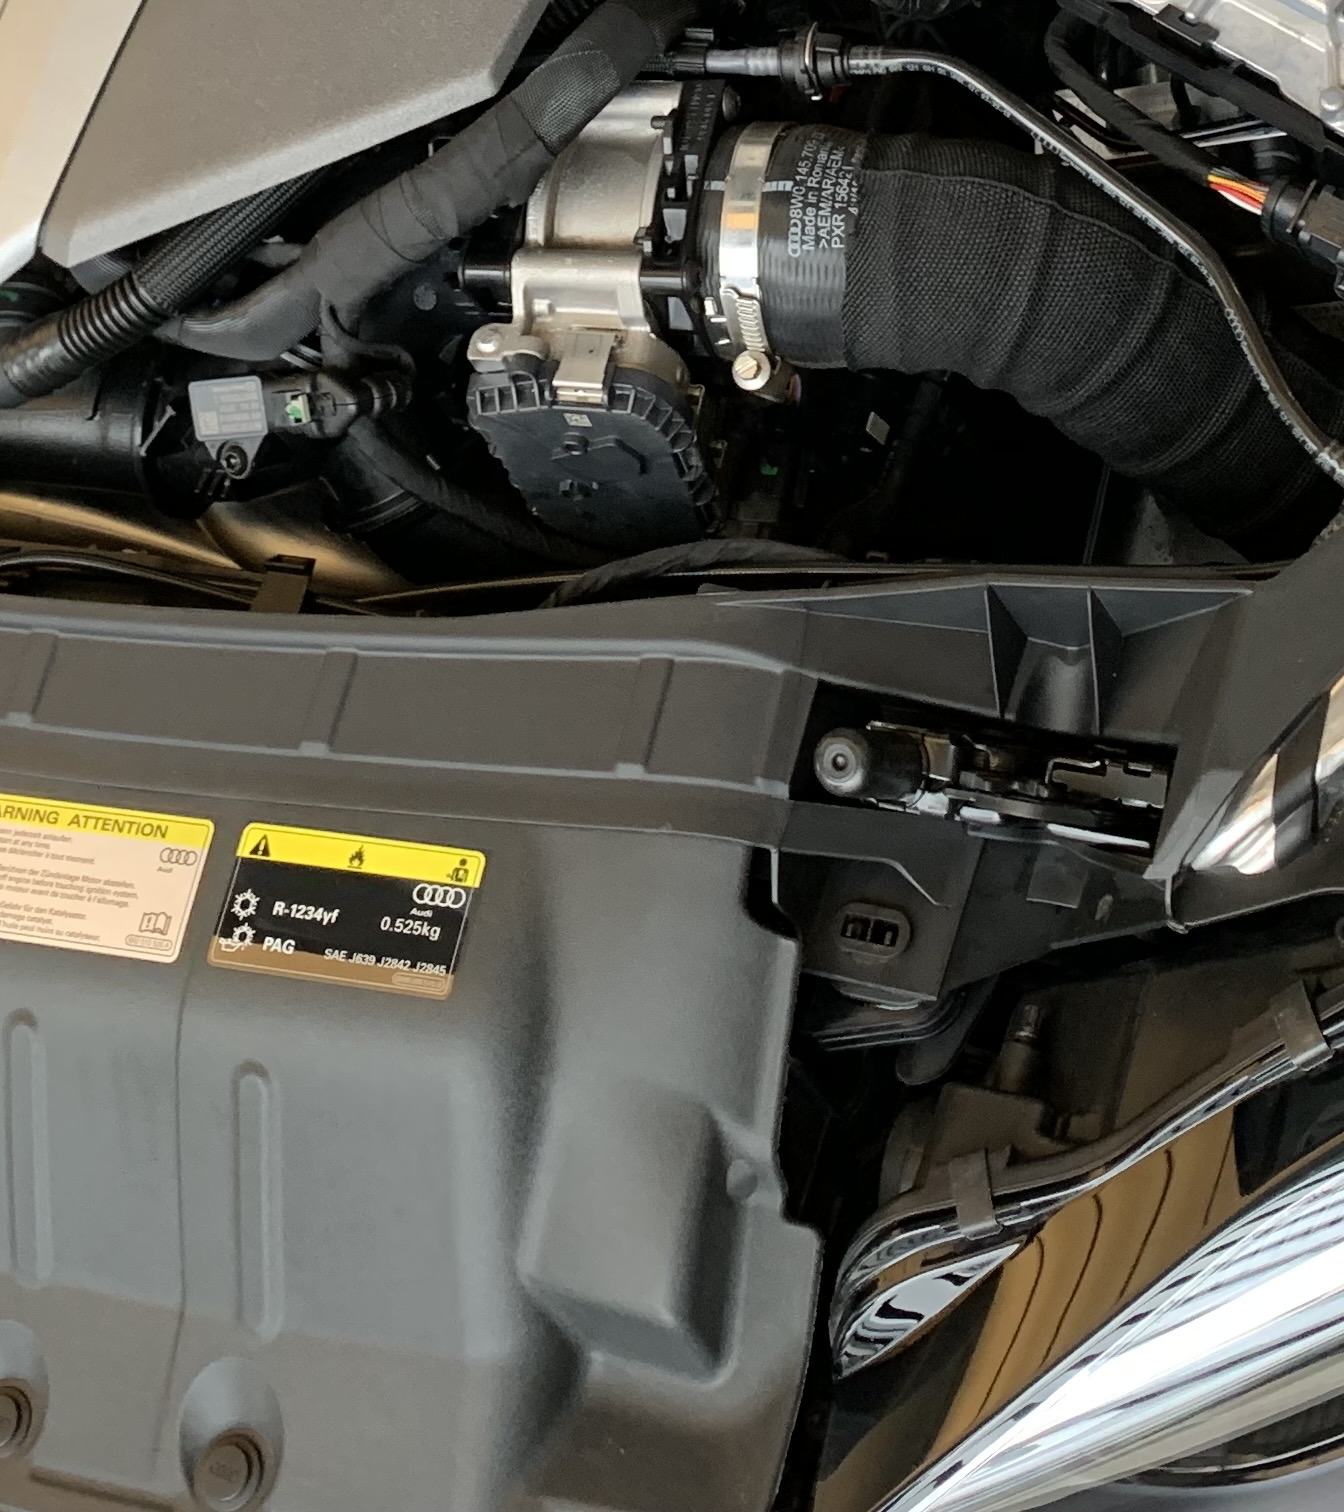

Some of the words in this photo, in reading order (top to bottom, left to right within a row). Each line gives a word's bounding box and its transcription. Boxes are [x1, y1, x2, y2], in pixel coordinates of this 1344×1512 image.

[806, 188, 819, 204] in
[801, 204, 817, 251] Made
[830, 211, 846, 249] PXR
[67, 814, 170, 840] ATTENTION
[272, 900, 340, 926] R-1234yf
[410, 907, 433, 918] Audi
[380, 916, 441, 941] 0.525kg
[262, 936, 296, 955] PAG
[324, 948, 346, 961] SAE
[348, 951, 376, 967] J639
[376, 956, 411, 972] J2842
[412, 960, 446, 977] J2845
